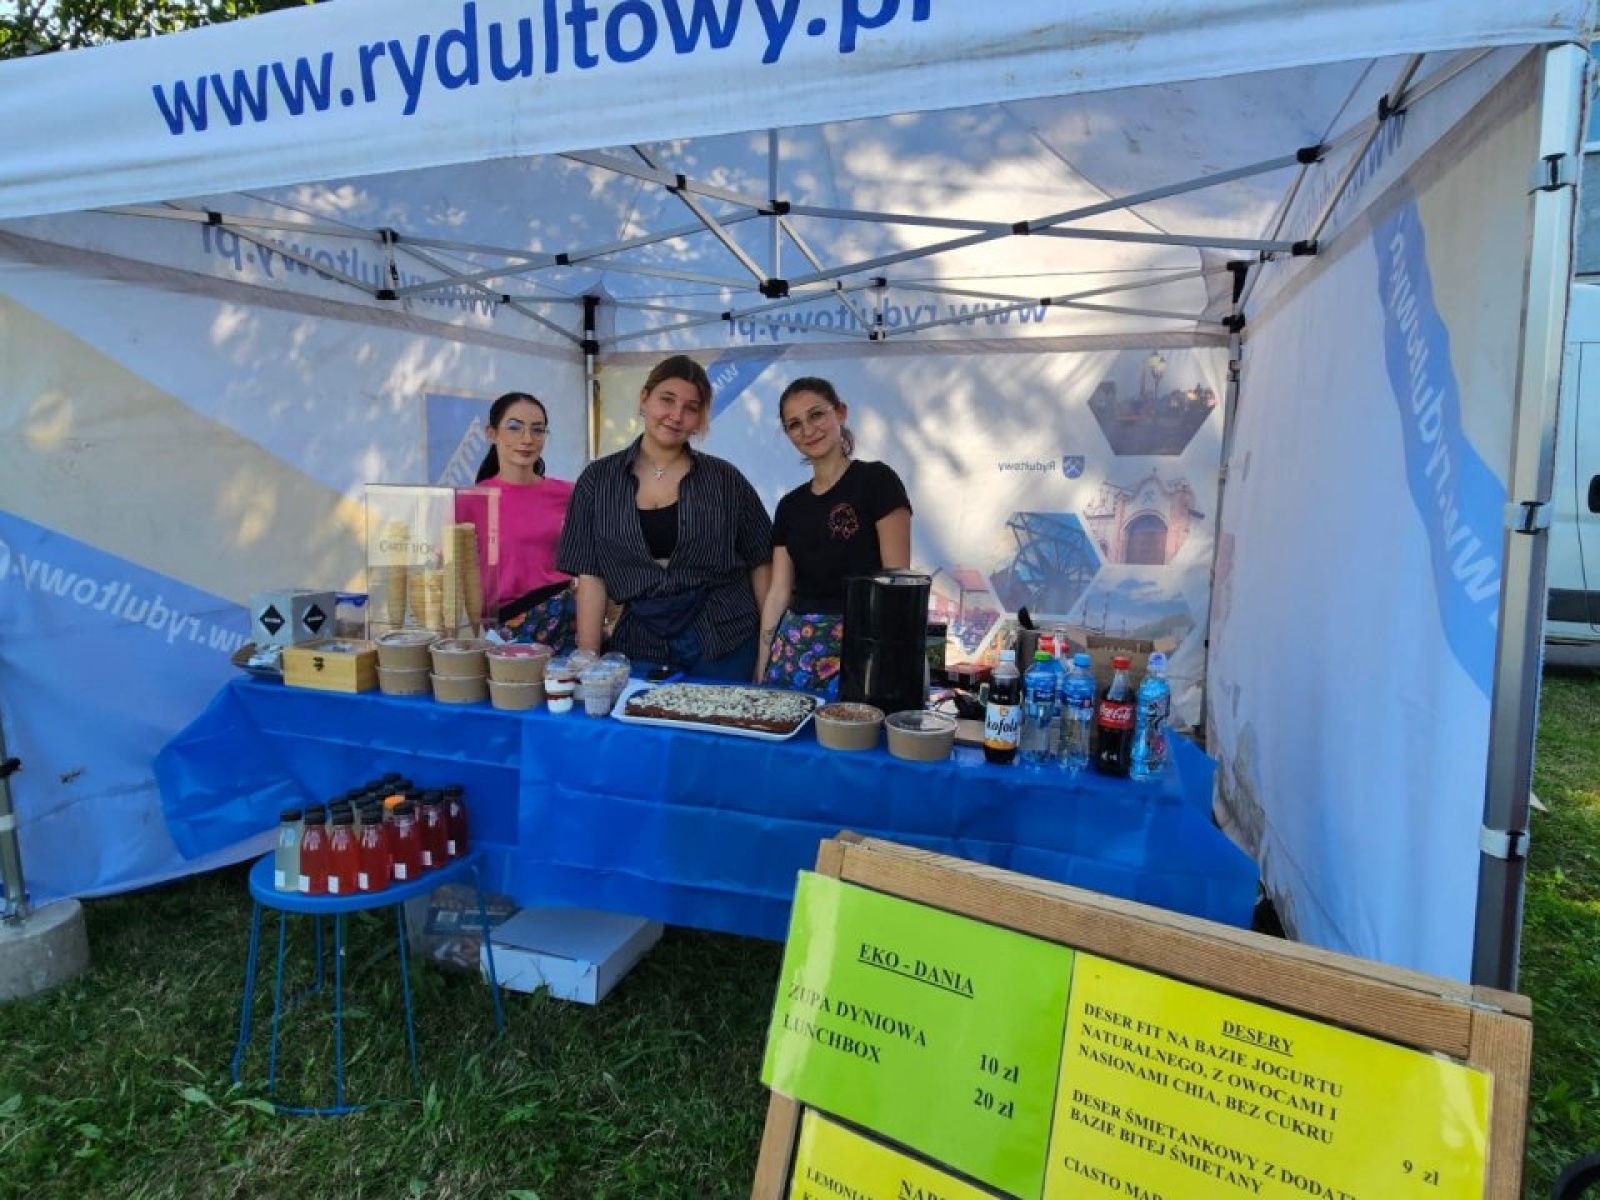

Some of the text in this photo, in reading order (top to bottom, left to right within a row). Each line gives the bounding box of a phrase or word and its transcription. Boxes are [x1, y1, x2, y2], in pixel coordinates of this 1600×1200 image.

[153, 0, 931, 135] www.rydultowy.p
[858, 943, 900, 969] EKO
[914, 959, 975, 995] DANIA
[783, 1013, 881, 1064] LUNCHBOX
[787, 982, 927, 1047] ZUPA DYNIOWA
[1221, 1019, 1294, 1053] DESERY
[979, 1053, 999, 1075] 10
[1084, 1002, 1344, 1098] DESER FIT NA BAZIE JOGURTU
[973, 1087, 994, 1111] 20
[1079, 1043, 1169, 1087] NASIONAMI
[1225, 1095, 1261, 1119] BEZ
[1264, 1108, 1334, 1145] CUKRU
[1212, 1067, 1224, 1082] Z
[1227, 1073, 1324, 1117] OWOCAMI
[1329, 1107, 1338, 1121] I
[1069, 1108, 1263, 1195] BAZIE BITEJ ŚMIETANY
[1072, 1089, 1356, 1200] DESER ŚMIETANKOWY Z DODAT
[1402, 1160, 1413, 1174] 9
[806, 1167, 873, 1200] LEMONI
[899, 1179, 947, 1200] NAP
[1063, 1156, 1122, 1191] CIASTO
